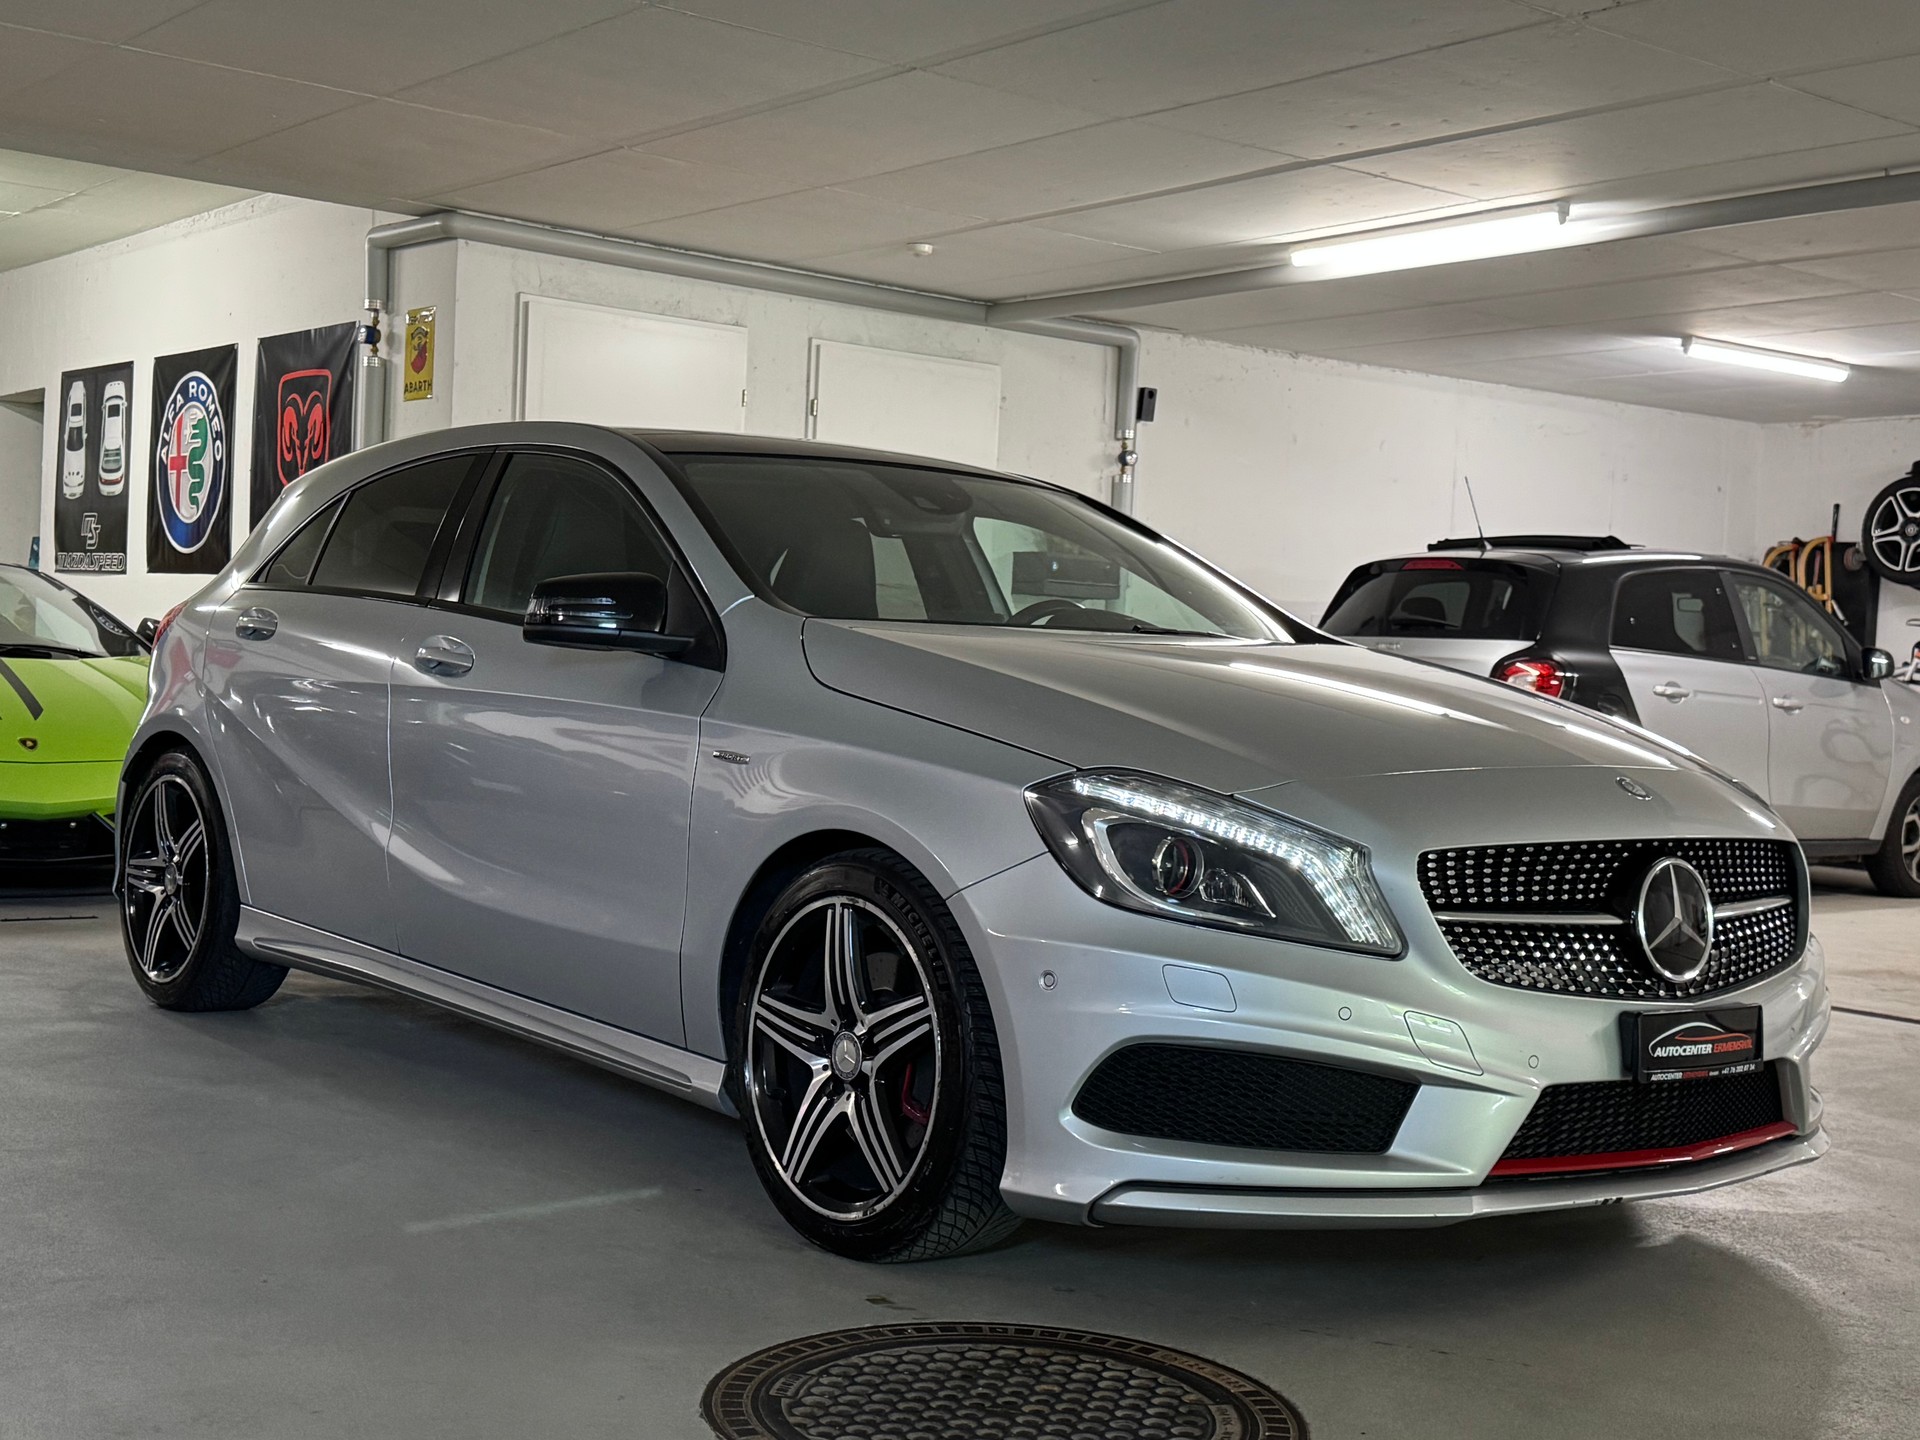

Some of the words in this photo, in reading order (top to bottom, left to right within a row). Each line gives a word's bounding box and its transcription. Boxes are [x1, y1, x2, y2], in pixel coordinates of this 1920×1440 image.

[404, 380, 433, 394] ABARTH
[160, 393, 185, 465] ALFA
[188, 381, 223, 462] ROMEO
[56, 552, 126, 571] MAZDASPEED
[889, 891, 949, 986] MICHELIN
[1654, 1044, 1713, 1057] AUTOCENTER
